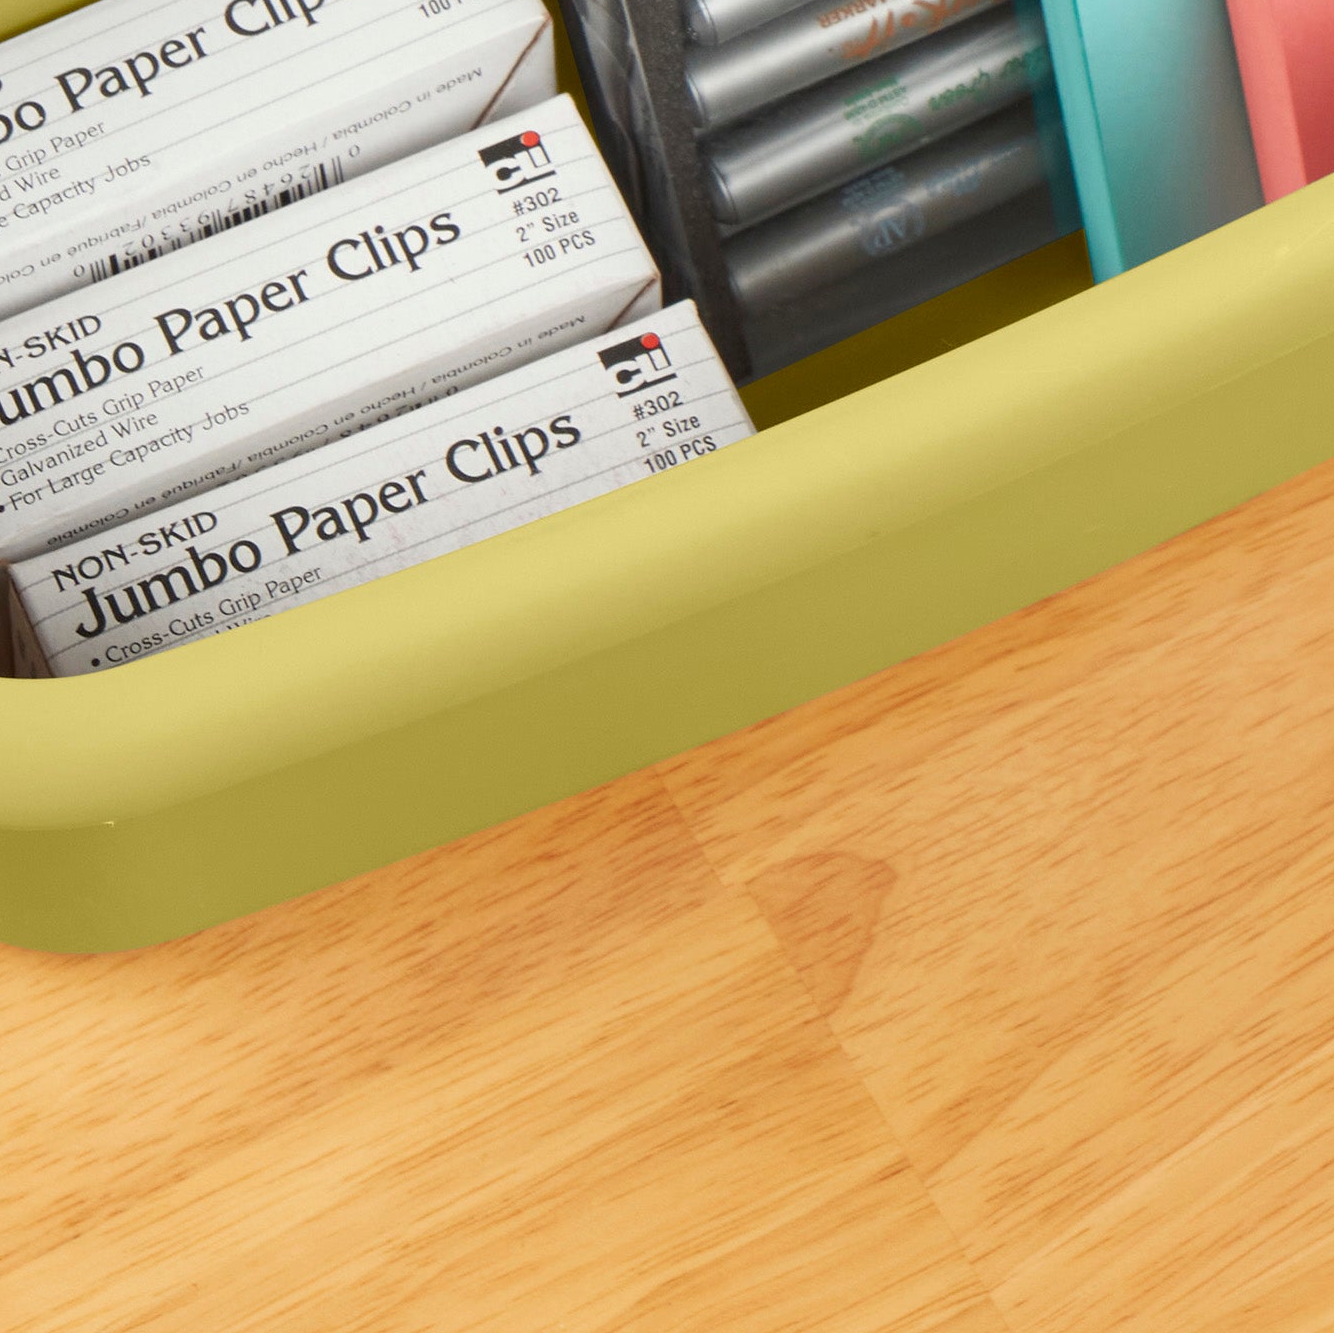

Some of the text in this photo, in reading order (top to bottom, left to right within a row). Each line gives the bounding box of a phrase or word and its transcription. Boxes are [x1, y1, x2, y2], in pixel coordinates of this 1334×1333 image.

[53, 26, 208, 113] Paper
[436, 66, 483, 94] Made
[417, 91, 432, 104] in
[332, 99, 412, 141] Colombia
[4, 145, 47, 177] Grip
[50, 120, 106, 153] Paper
[263, 141, 319, 172] Hecho
[348, 144, 362, 158] 0
[12, 176, 96, 220] Capacity
[103, 153, 151, 183] Jobs
[14, 166, 61, 193] Wire
[236, 167, 258, 183] en
[151, 179, 232, 220] Colombia
[513, 187, 563, 217] #302
[542, 209, 580, 232] Size
[40, 251, 62, 267] en
[522, 229, 596, 269] 100 PCS
[73, 264, 86, 278] 0
[153, 269, 310, 356] Paper
[326, 211, 461, 282] Clips
[517, 336, 533, 350] in
[537, 314, 586, 341] Made
[431, 346, 512, 386] Colombia
[101, 389, 145, 423] Grip
[147, 365, 205, 399] Paper
[361, 386, 417, 417] Hecho
[632, 390, 684, 421] #302
[334, 412, 356, 427] en
[662, 413, 701, 438] Size
[0, 411, 160, 489] Galvanized Wire
[9, 398, 250, 512] For Large Capacity Jobs
[246, 423, 329, 465] Colombia
[642, 435, 718, 474] 100 PCS
[133, 495, 156, 510] en
[47, 508, 129, 546] Colombie
[75, 413, 581, 640] Jumbo Paper Clips
[51, 511, 218, 593] NON-SKID
[104, 609, 214, 666] Cross-Cuts
[217, 590, 262, 624] Grip
[265, 566, 322, 598] Paper
